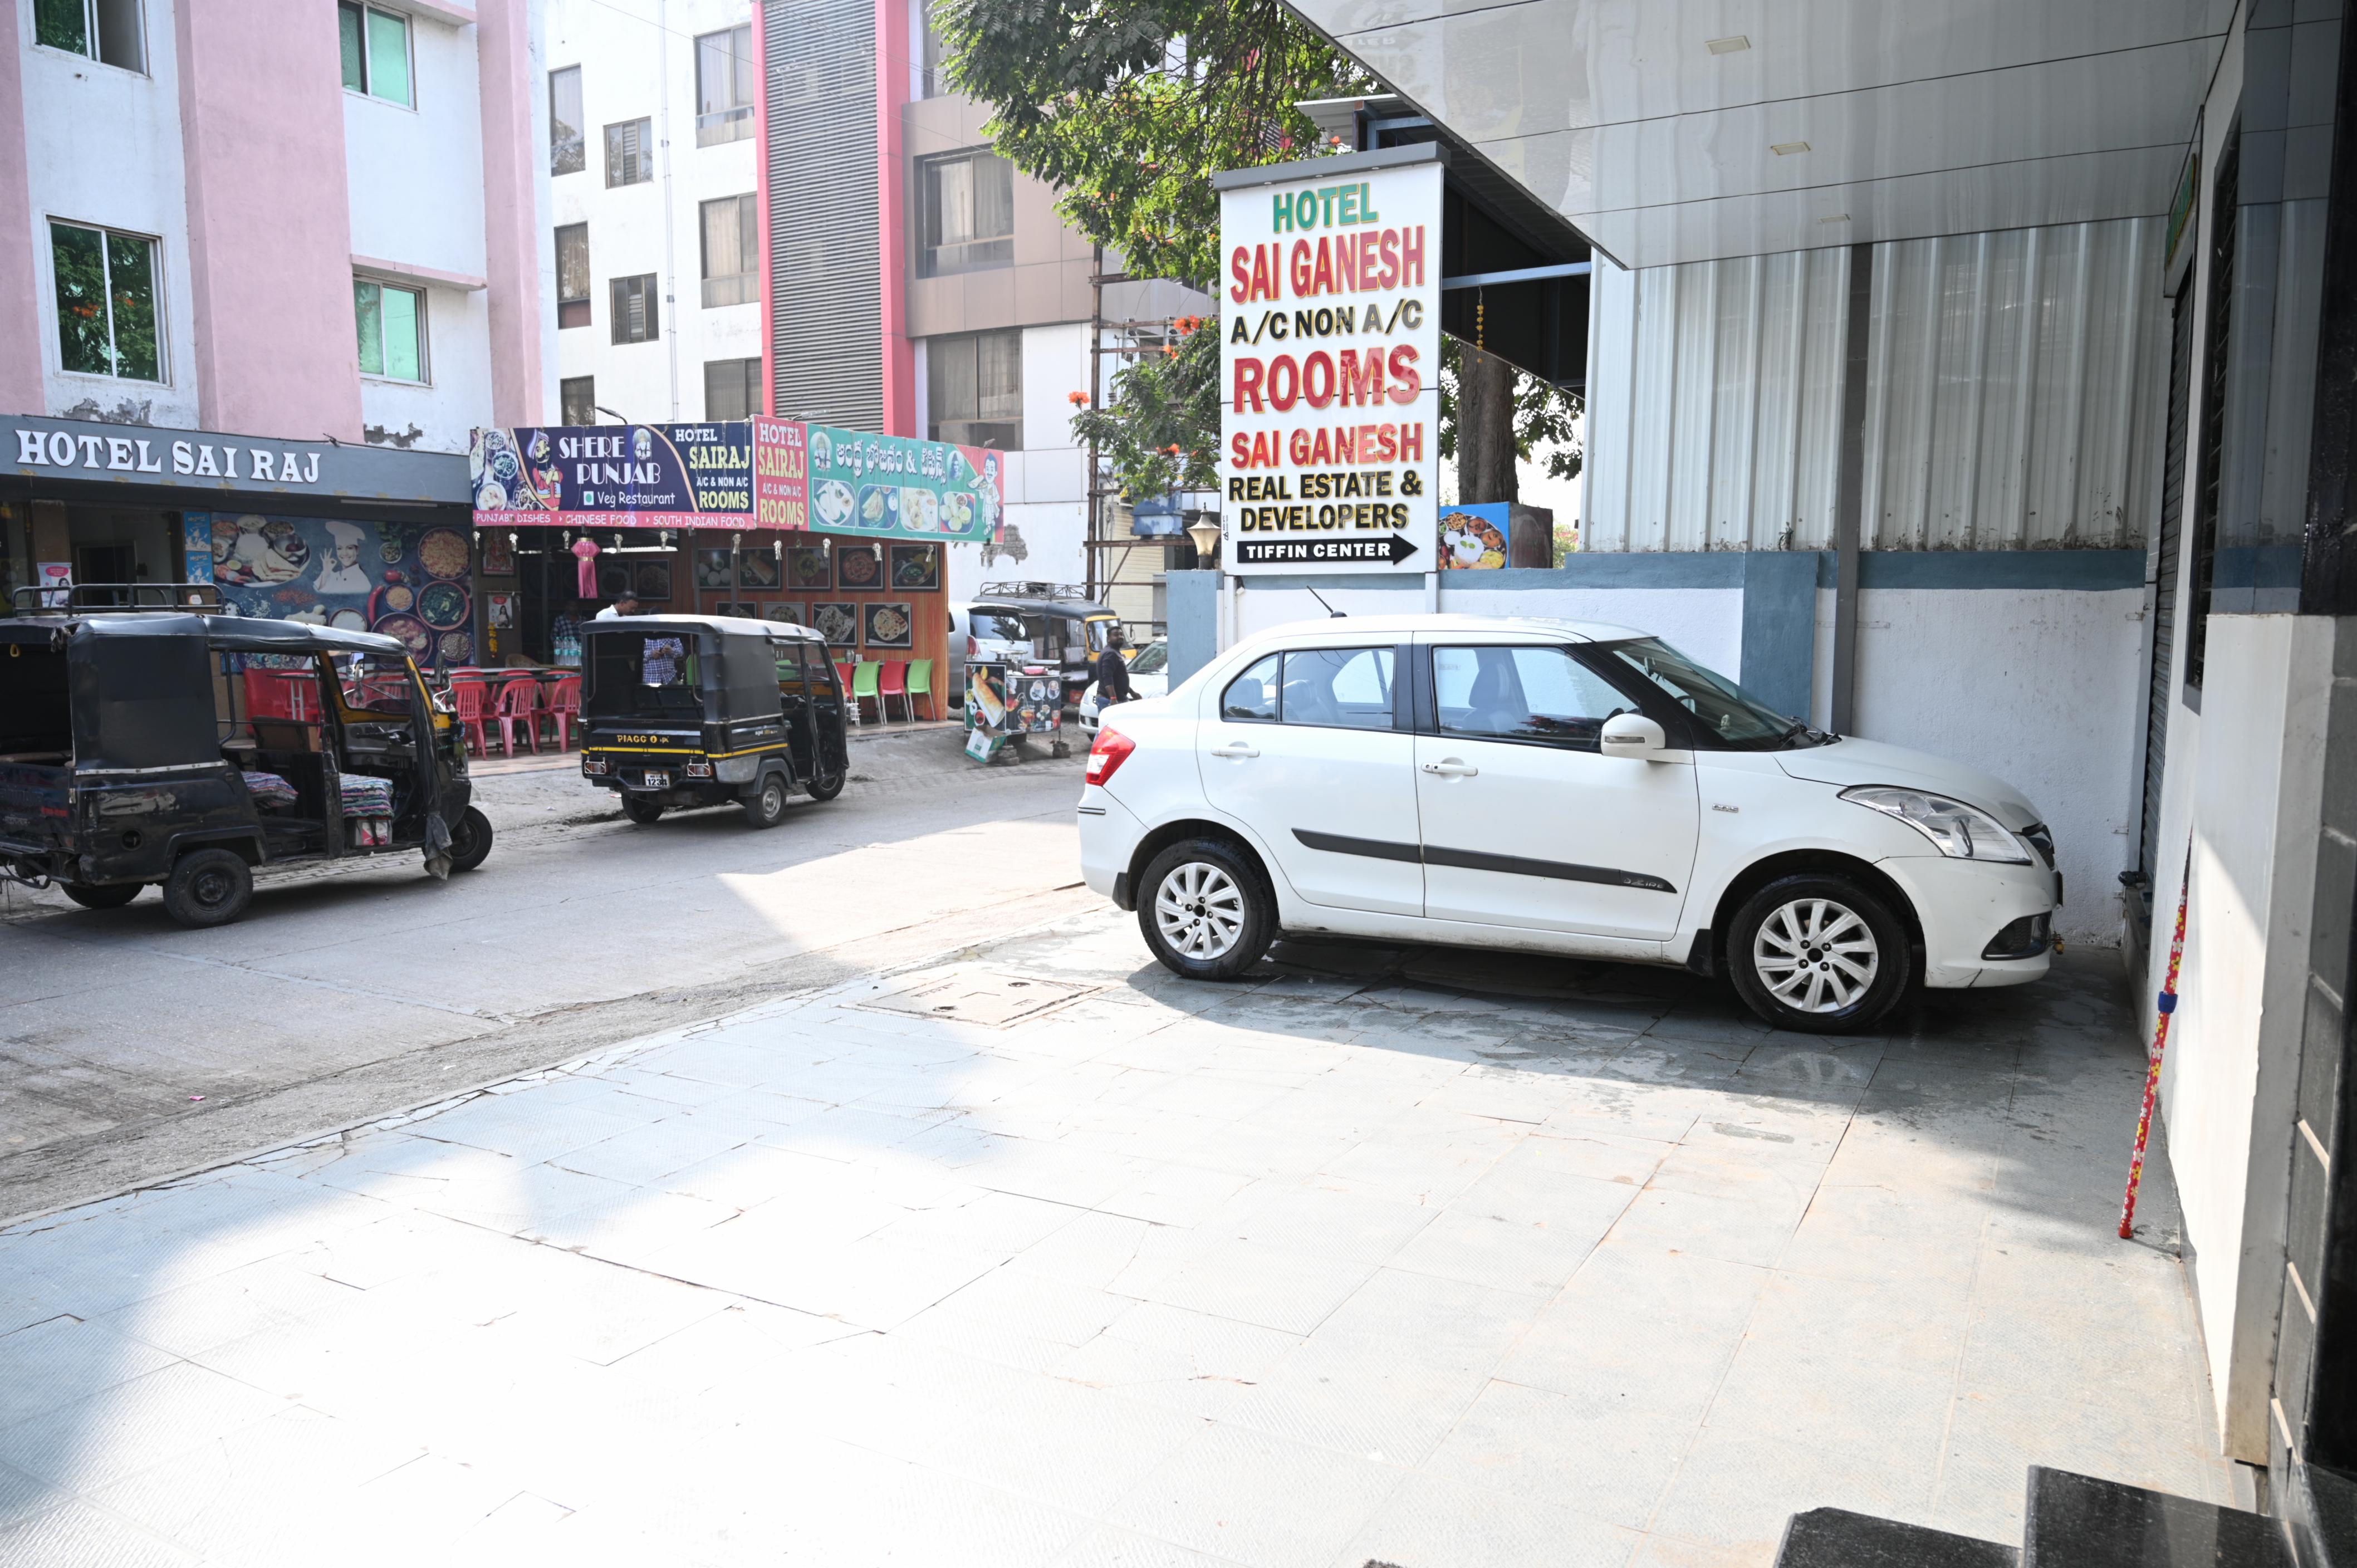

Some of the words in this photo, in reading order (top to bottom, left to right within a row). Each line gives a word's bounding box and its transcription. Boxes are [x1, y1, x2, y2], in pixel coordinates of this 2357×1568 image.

[1272, 182, 1379, 233] HOTEL
[1230, 242, 1281, 305] SAI
[1290, 225, 1424, 298] GANESH
[1230, 310, 1289, 345] A/C
[1295, 306, 1355, 339] NON
[1361, 298, 1423, 335] A/C
[1233, 344, 1420, 414] ROOMS
[675, 429, 717, 442] HOTEL
[759, 423, 802, 447] HOTEL
[1230, 429, 1280, 469] SAI
[1290, 422, 1423, 466] GANESH
[15, 429, 161, 473] HOTEL
[172, 440, 238, 478] SAI
[249, 449, 321, 483] RAJ
[559, 437, 625, 458] SHERE
[689, 446, 750, 469] SAIRAJ
[758, 446, 804, 479] SAIRAJ
[906, 449, 917, 474] &
[577, 463, 660, 484] PUNJAB
[697, 477, 708, 487] A/C
[709, 477, 716, 486] &
[718, 477, 734, 487] NON
[736, 477, 748, 487] A/C
[773, 484, 777, 494] &
[780, 484, 791, 496] NON
[1229, 476, 1292, 502] REAL
[1300, 471, 1393, 499] ESTATE
[1400, 469, 1423, 496] &
[597, 492, 616, 507] Veg
[619, 492, 675, 504] Restaurant
[699, 491, 748, 509] ROOMS
[477, 513, 514, 523] PUNJABI
[517, 514, 551, 523] DISHES
[566, 514, 606, 524] CHINESE
[610, 514, 636, 525] FOOD
[653, 516, 683, 526] SOUTH
[685, 516, 718, 526] INDIAN
[721, 517, 745, 527] FOOD
[760, 499, 805, 526] ROOMS
[1241, 503, 1409, 532] DEVELOPERS
[1247, 545, 1307, 558] TIFFIN
[1313, 543, 1390, 557] CENTER
[616, 735, 657, 743] PIAGGO
